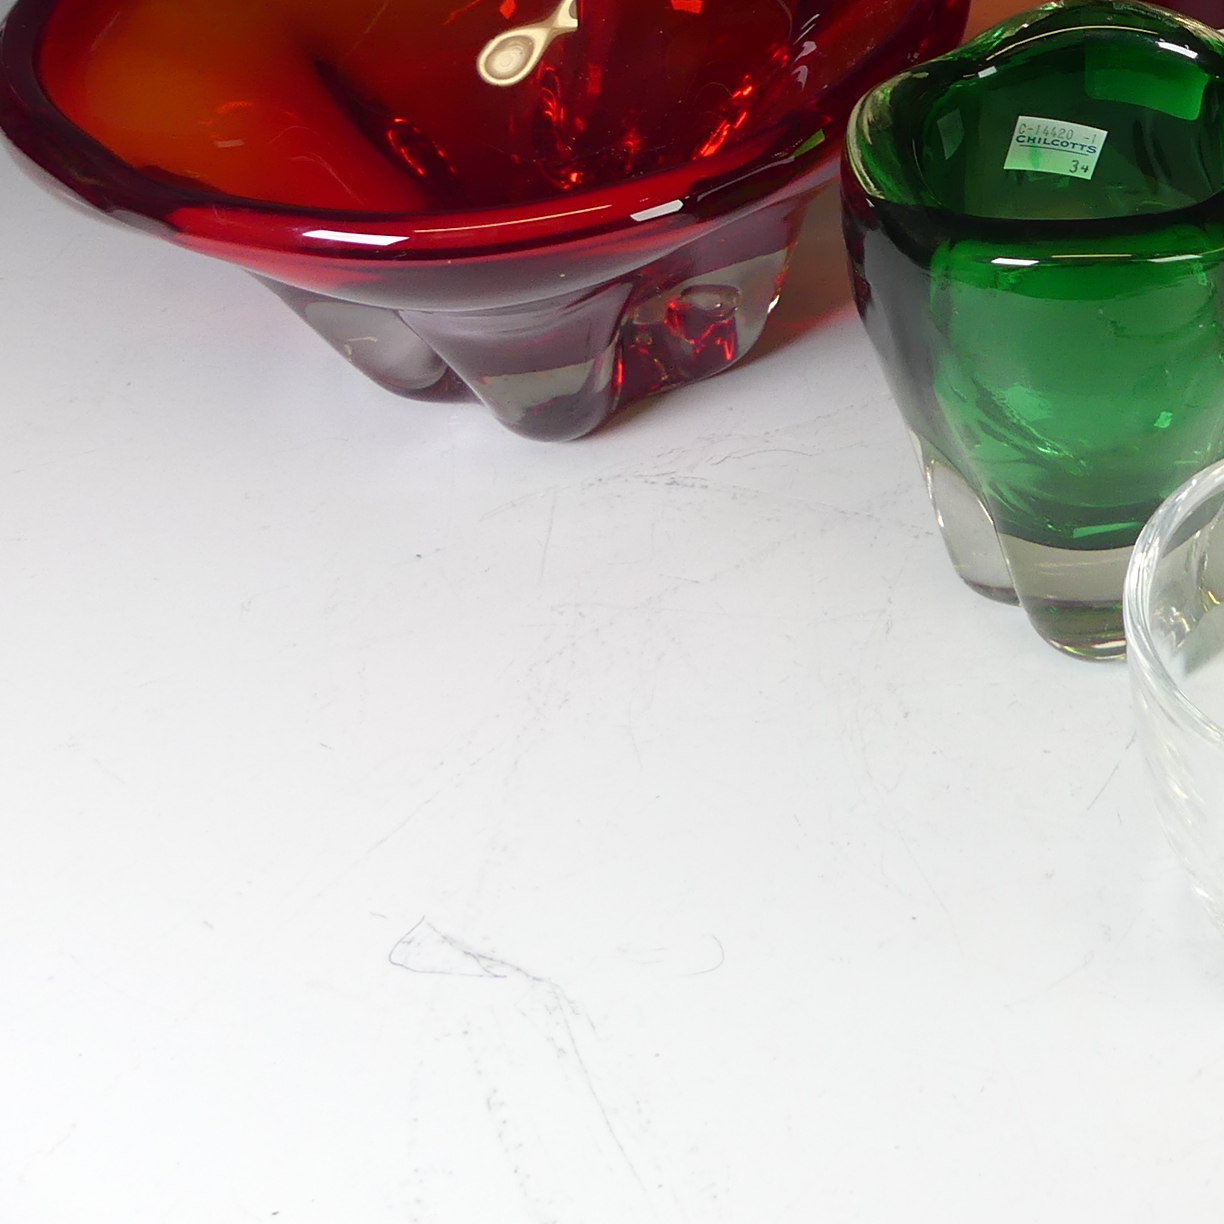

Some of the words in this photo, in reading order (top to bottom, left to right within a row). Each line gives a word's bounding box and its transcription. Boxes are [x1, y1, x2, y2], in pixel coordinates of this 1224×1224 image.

[1018, 123, 1074, 140] C-14420
[1016, 134, 1097, 154] CHILCOTTS
[1069, 159, 1089, 173] 34
